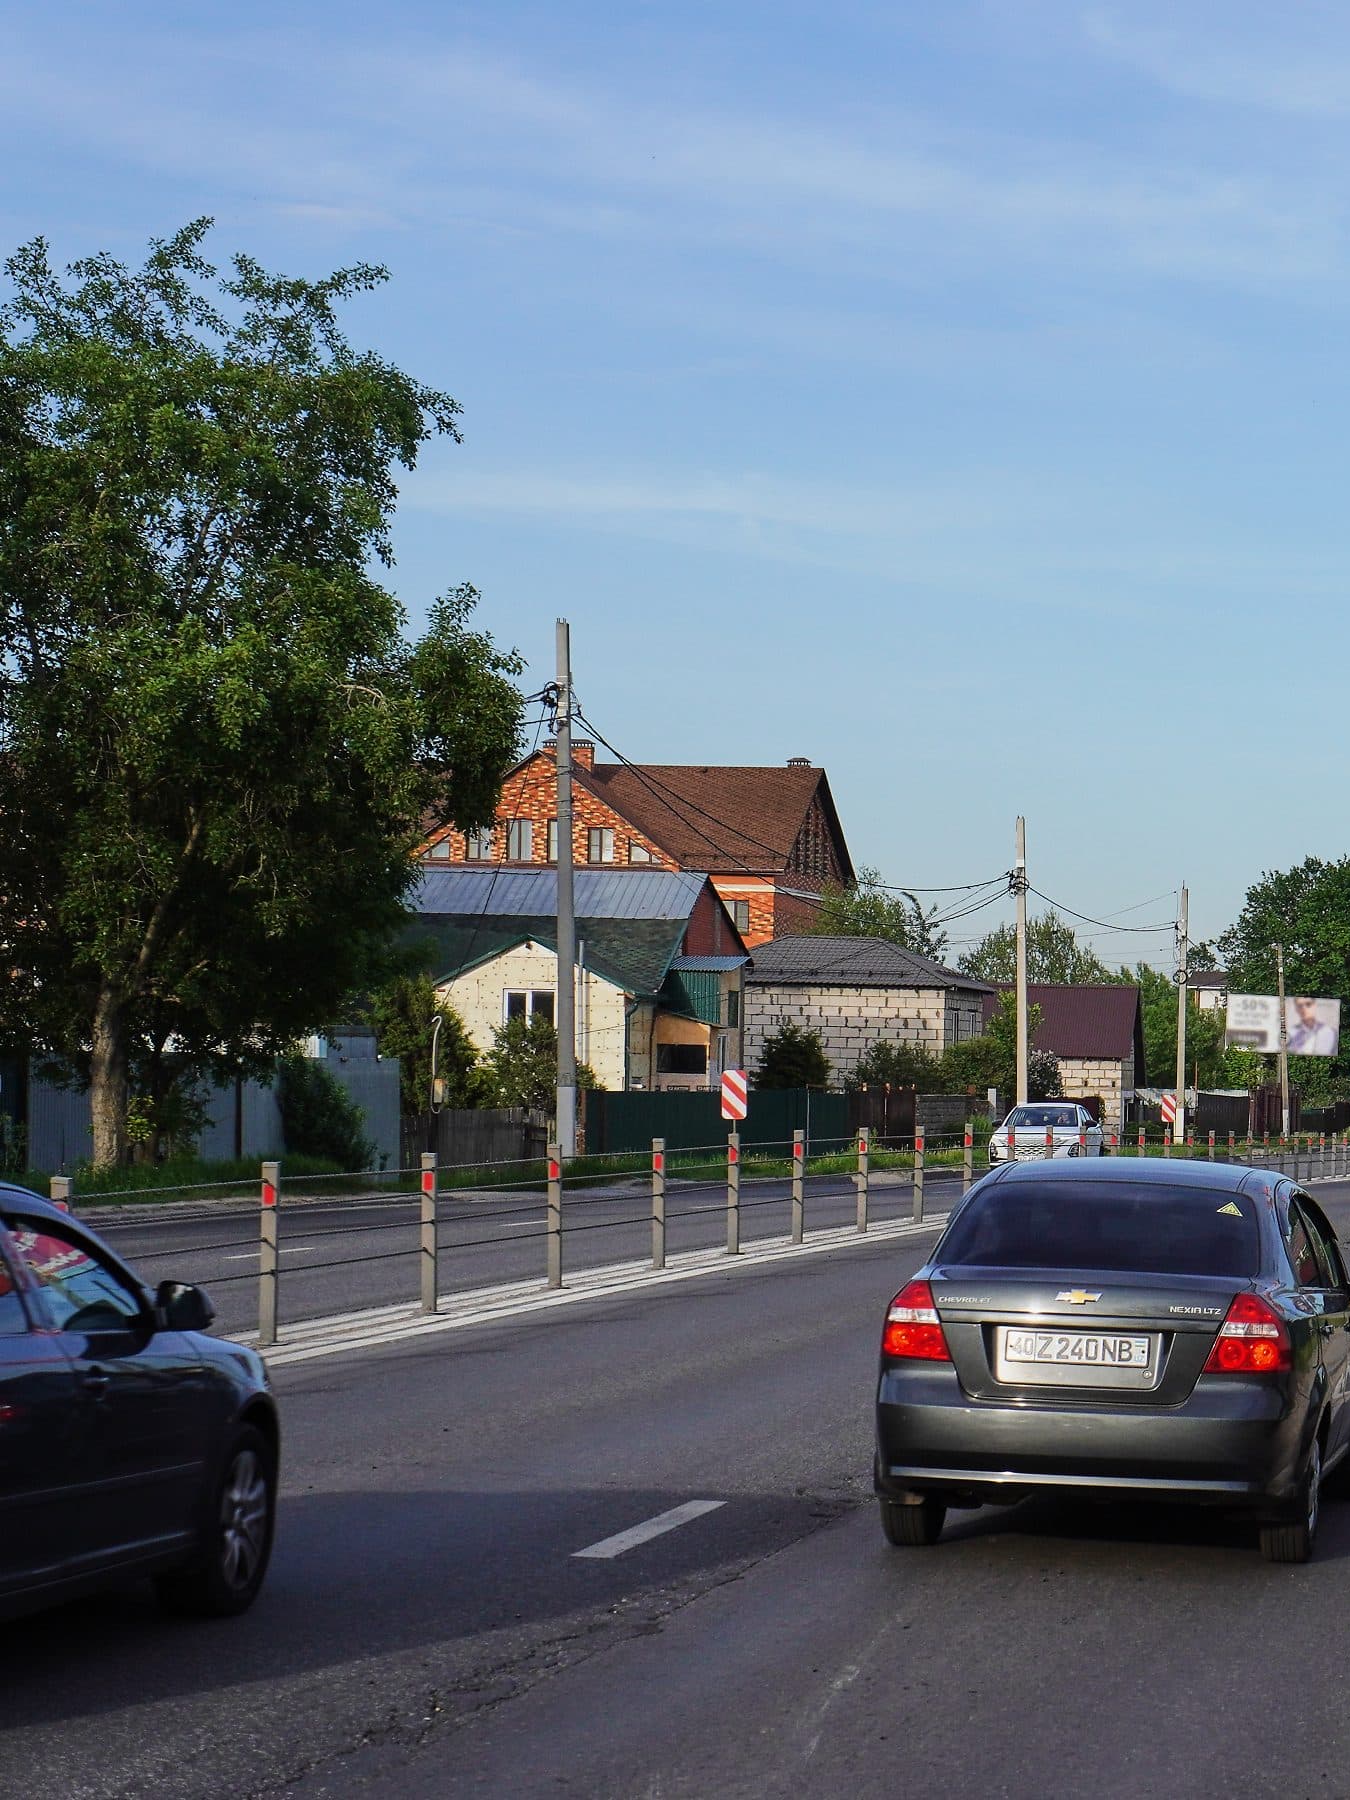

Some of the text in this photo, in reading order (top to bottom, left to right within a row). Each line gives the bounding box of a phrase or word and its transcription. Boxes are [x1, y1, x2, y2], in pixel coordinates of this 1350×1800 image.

[938, 1296, 992, 1304] CHEVROLET
[1169, 1306, 1222, 1315] NEXIA LTZ
